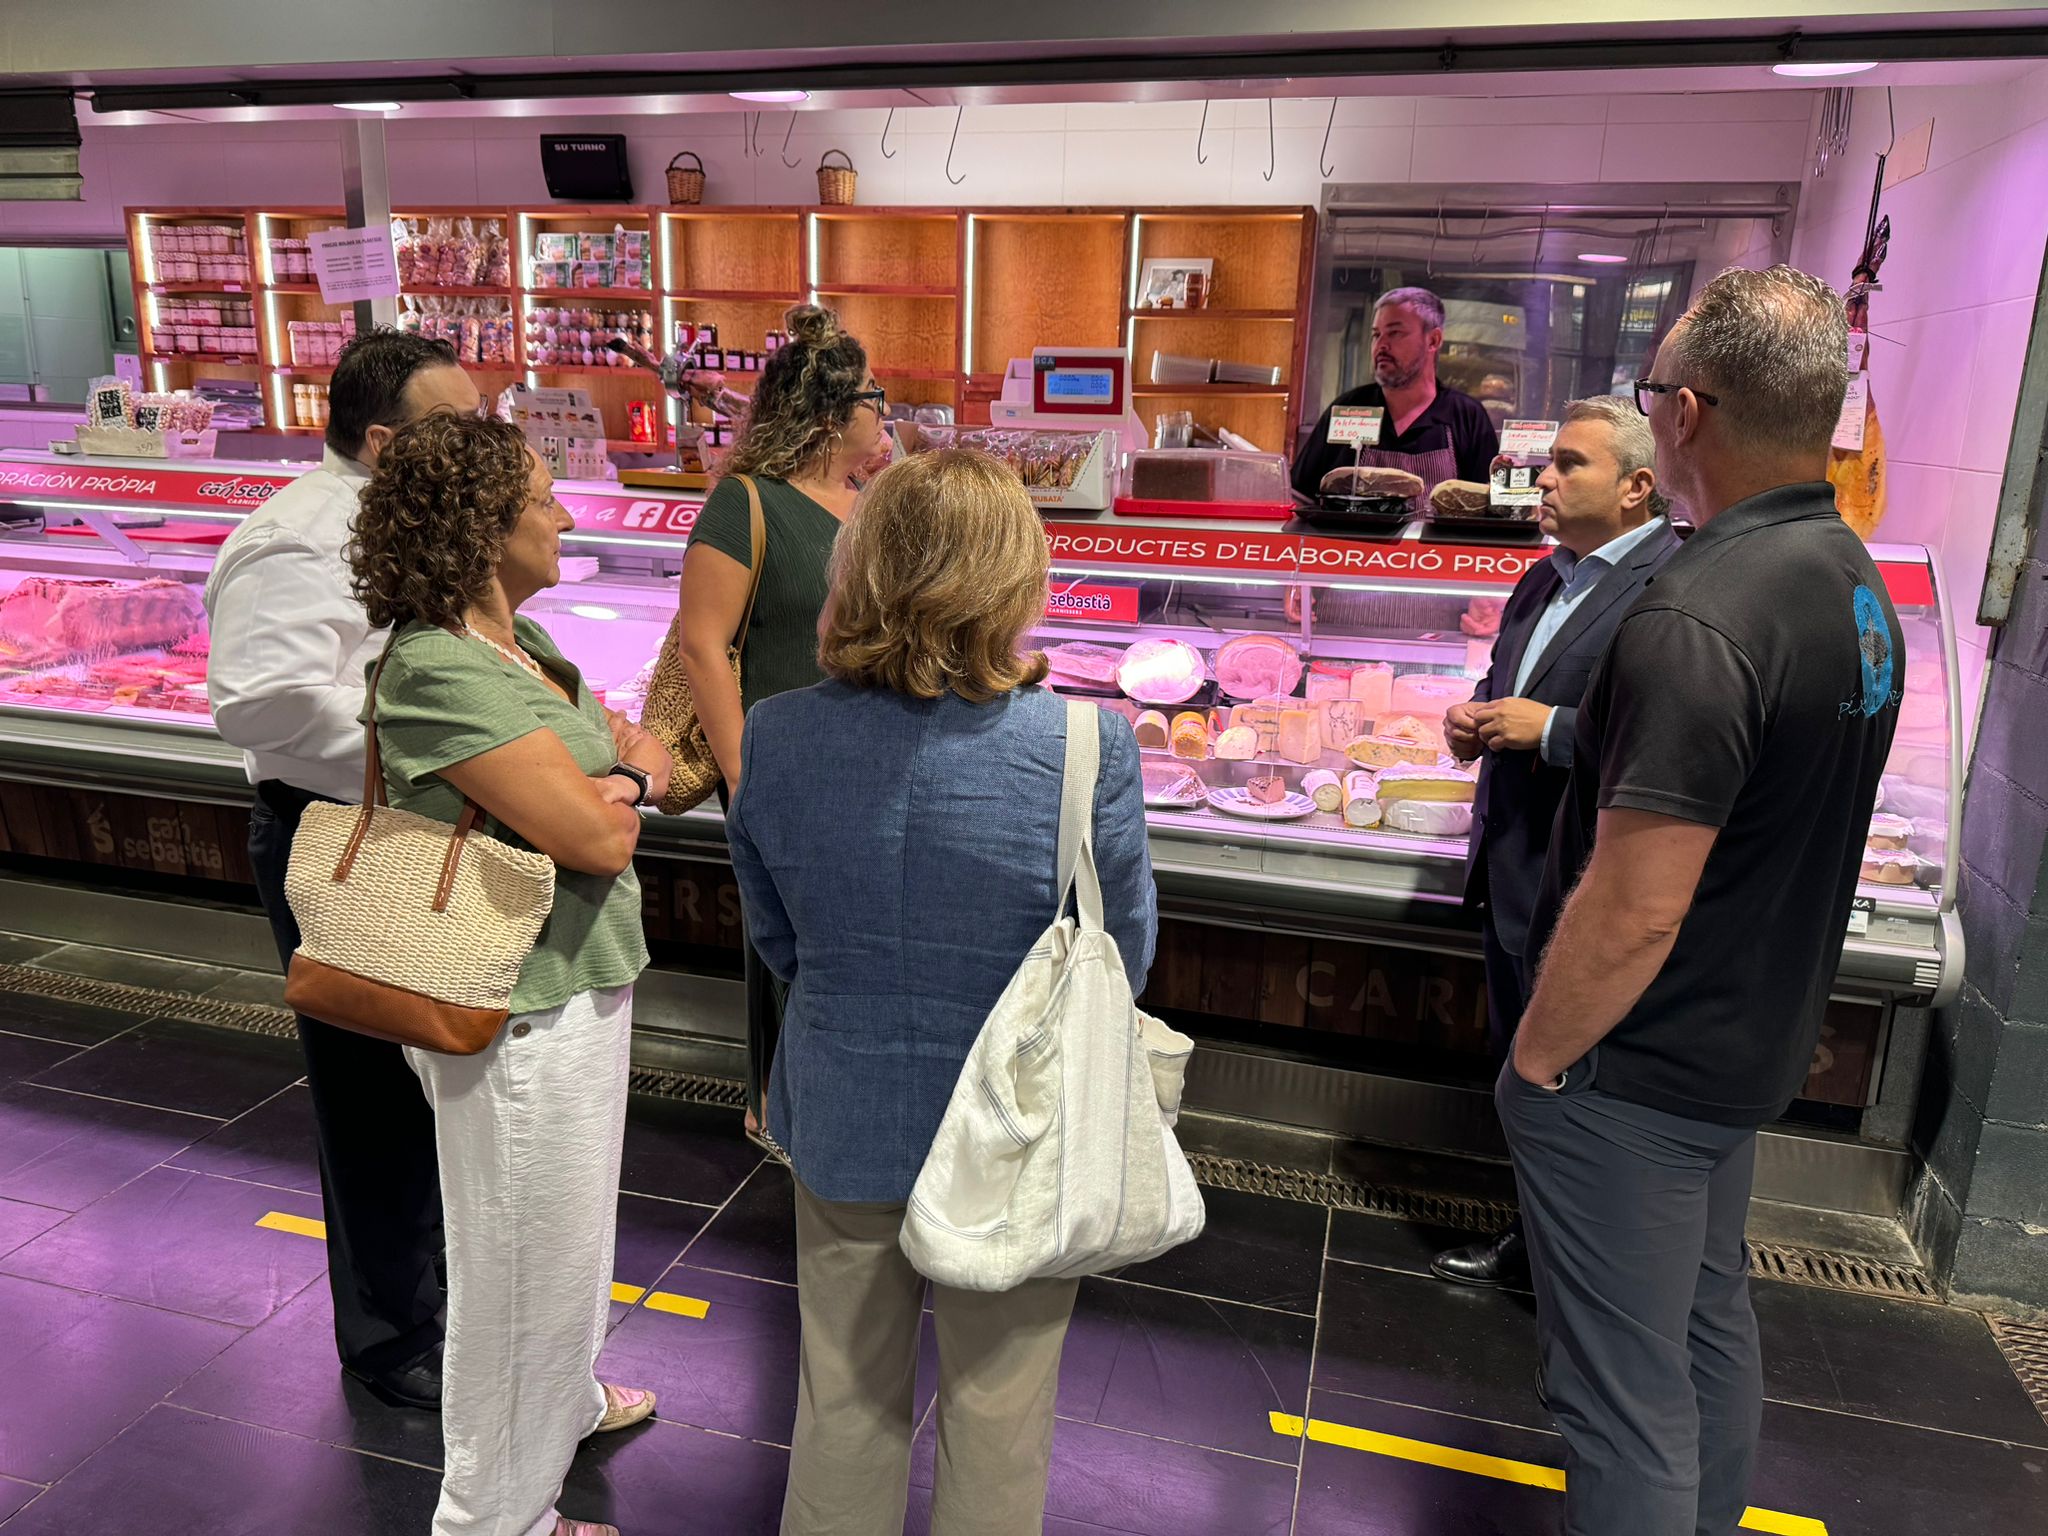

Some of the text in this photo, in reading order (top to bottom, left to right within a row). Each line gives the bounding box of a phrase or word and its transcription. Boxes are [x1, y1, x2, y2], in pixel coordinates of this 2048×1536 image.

[554, 143, 606, 151] SU TURNO
[80, 475, 157, 494] PRÓPIA
[1215, 541, 1443, 571] D'ELABORACIÓ
[1049, 591, 1112, 611] sebastià
[123, 837, 223, 869] sebastià
